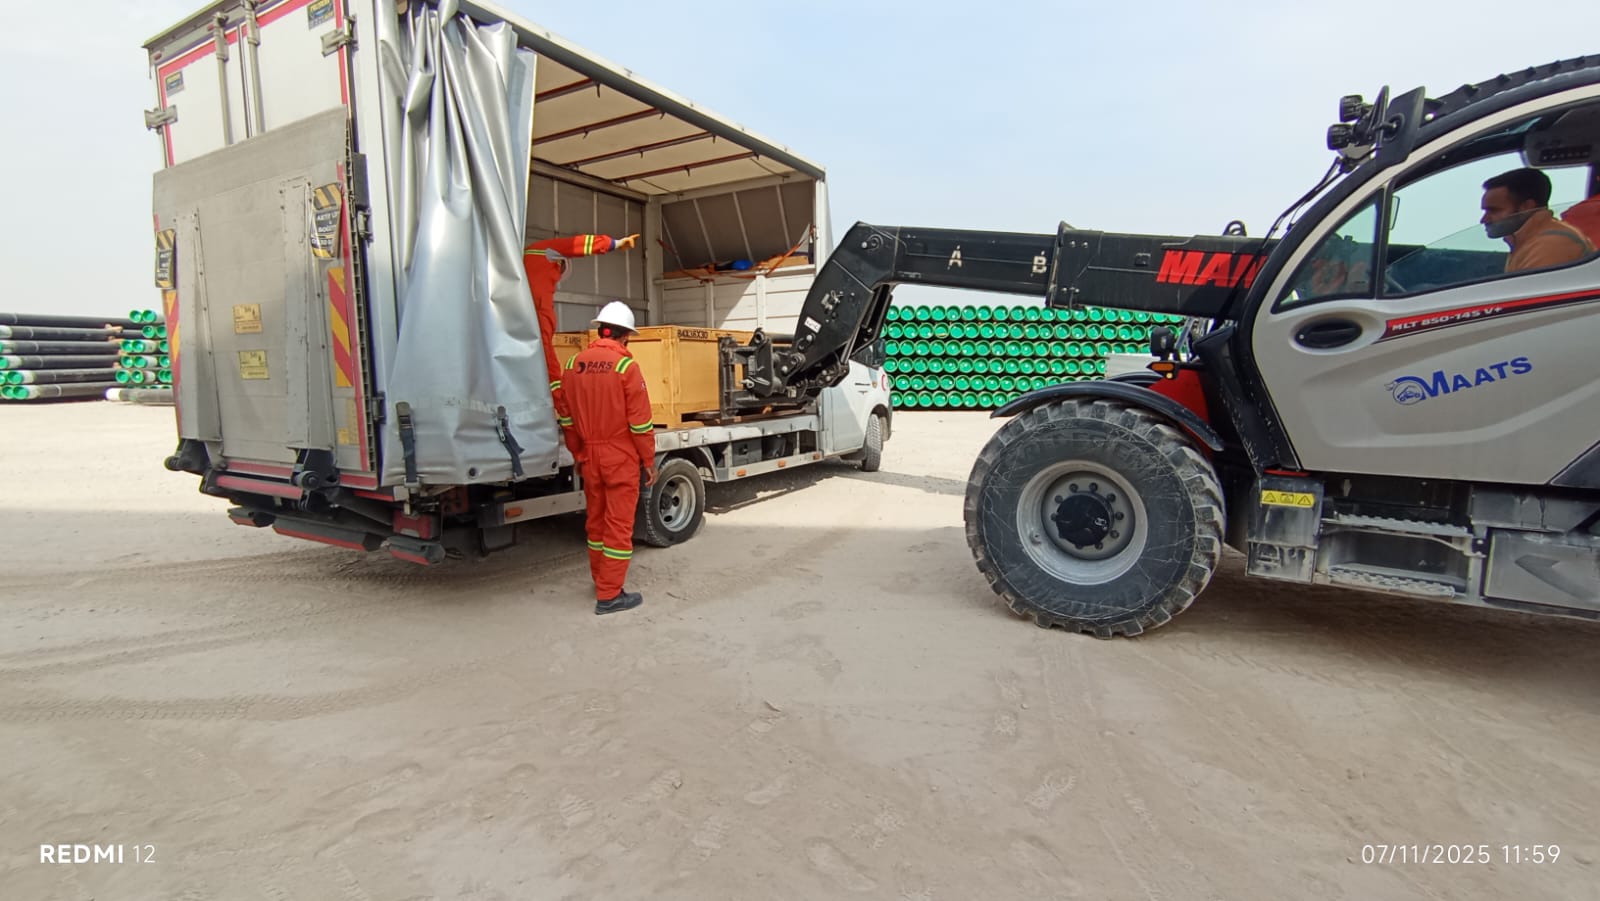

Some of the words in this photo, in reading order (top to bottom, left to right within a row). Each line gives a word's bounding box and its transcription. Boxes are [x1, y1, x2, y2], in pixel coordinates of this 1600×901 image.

[949, 249, 962, 268] A
[1032, 255, 1047, 273] B
[1391, 320, 1419, 331] MLT
[1421, 309, 1481, 326] 850-145
[1484, 306, 1503, 315] V+
[587, 360, 614, 370] PARS
[1394, 356, 1532, 400] MAATS
